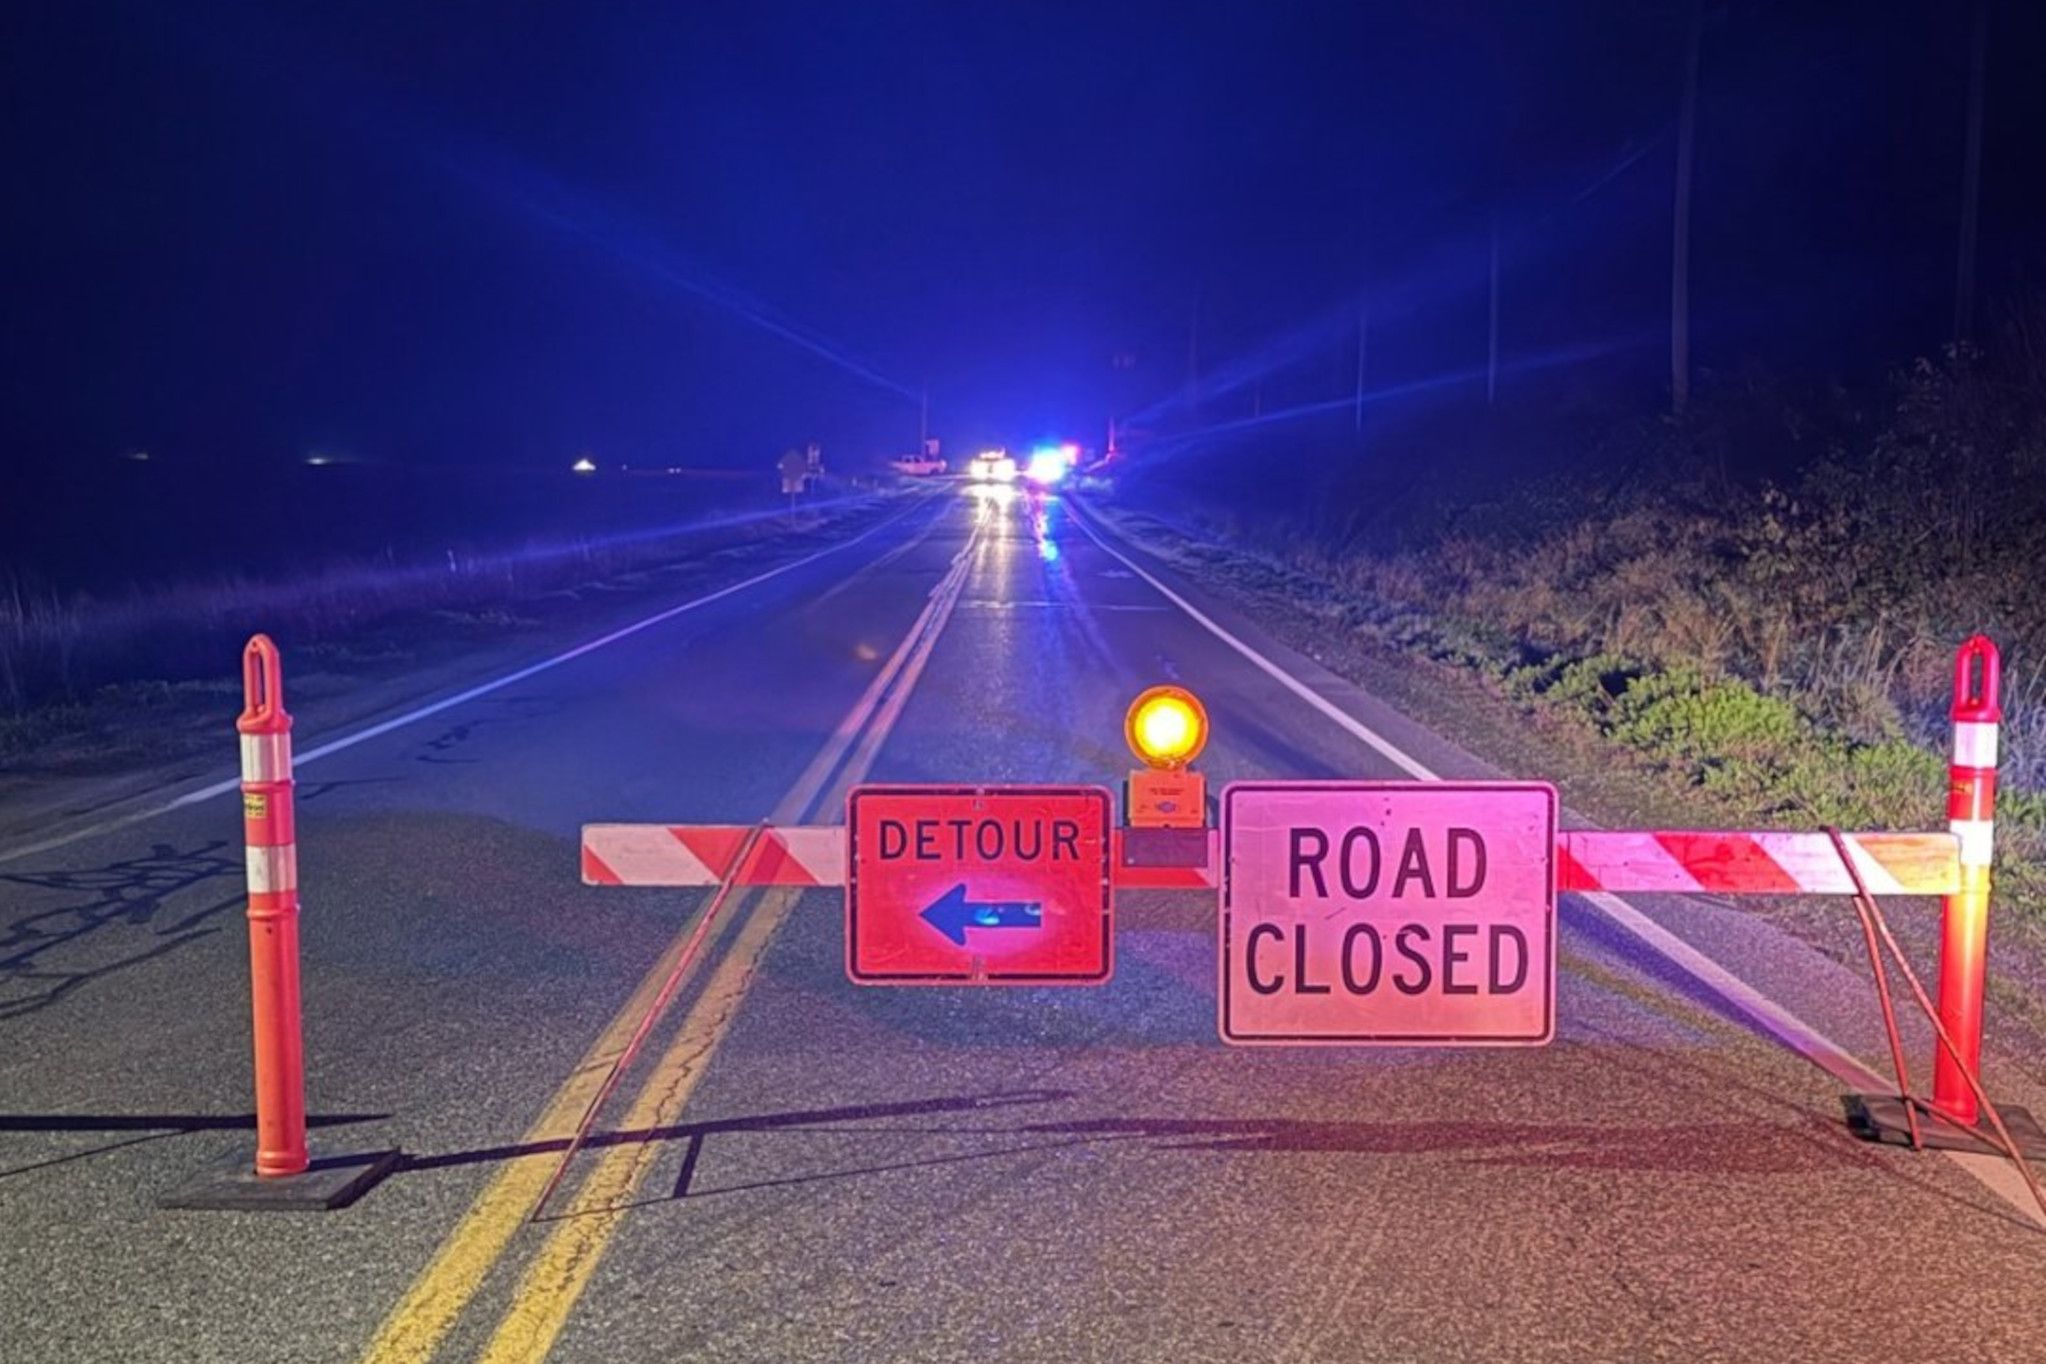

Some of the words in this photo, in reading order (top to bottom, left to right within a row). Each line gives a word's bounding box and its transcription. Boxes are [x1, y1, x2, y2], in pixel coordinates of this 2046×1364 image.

[879, 819, 1080, 860] DETOUR
[1289, 827, 1488, 899] ROAD
[1246, 923, 1529, 995] CLOSED
